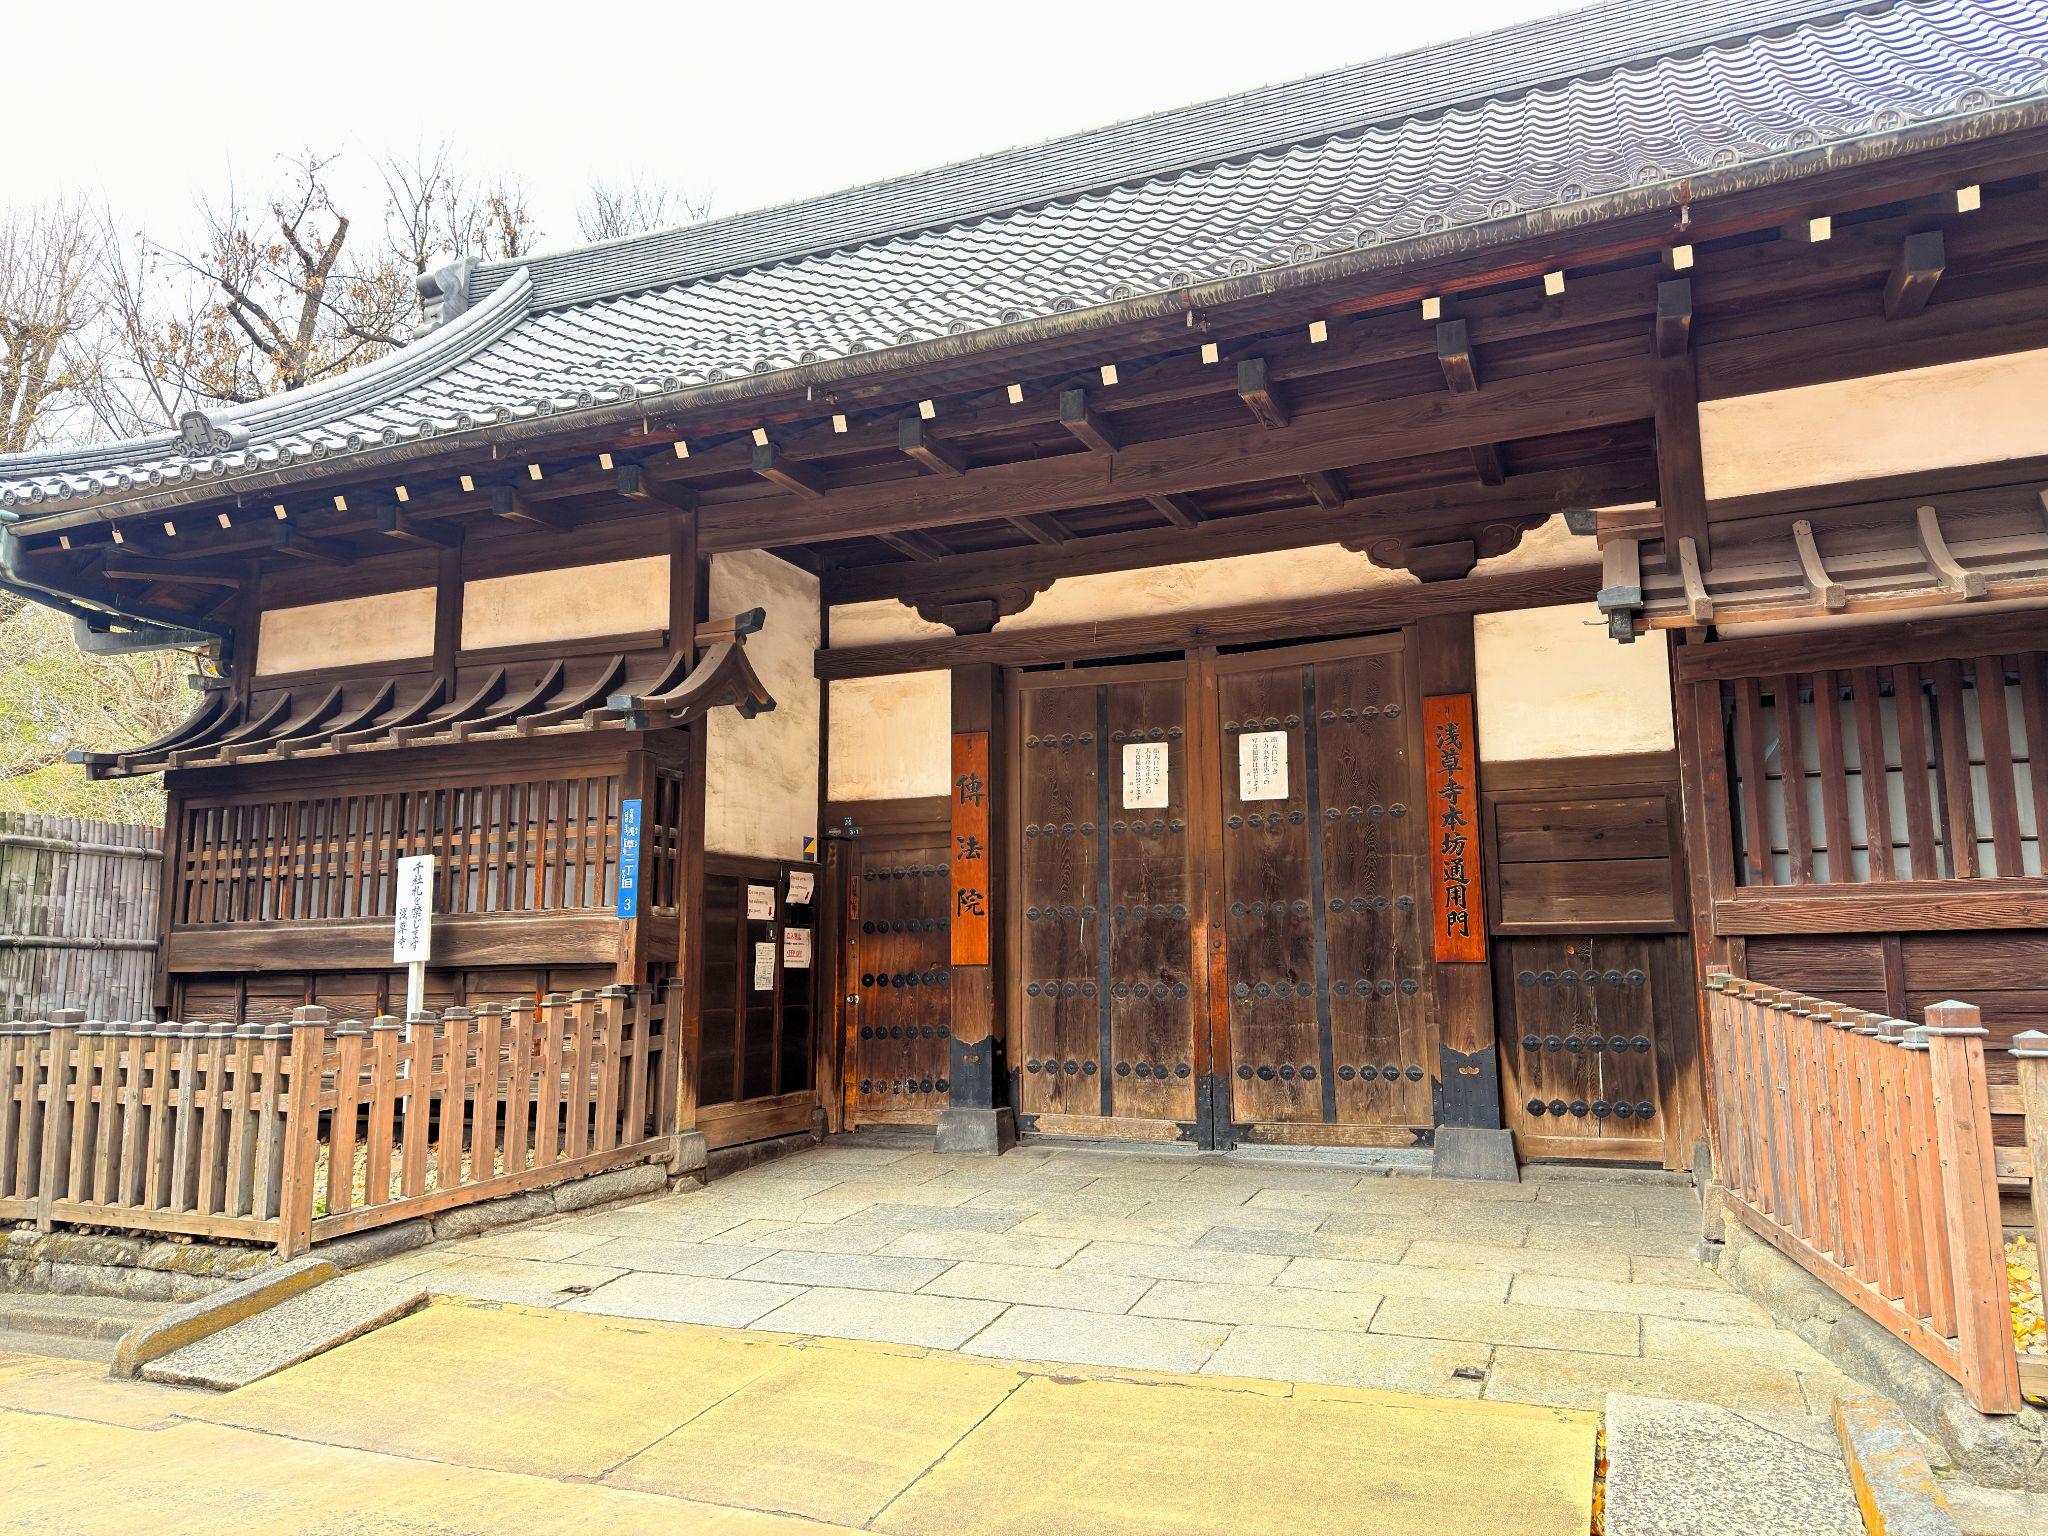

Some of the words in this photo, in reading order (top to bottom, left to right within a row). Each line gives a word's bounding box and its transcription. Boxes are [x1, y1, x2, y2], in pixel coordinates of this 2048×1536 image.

[623, 826, 635, 889] 浅草二丁目
[955, 771, 986, 917] 傳法院
[1435, 721, 1471, 938] 浅草寺本坊通用門
[397, 907, 408, 949] 浅草寺
[410, 861, 424, 951] 千社札を禁じます
[623, 898, 632, 911] 3
